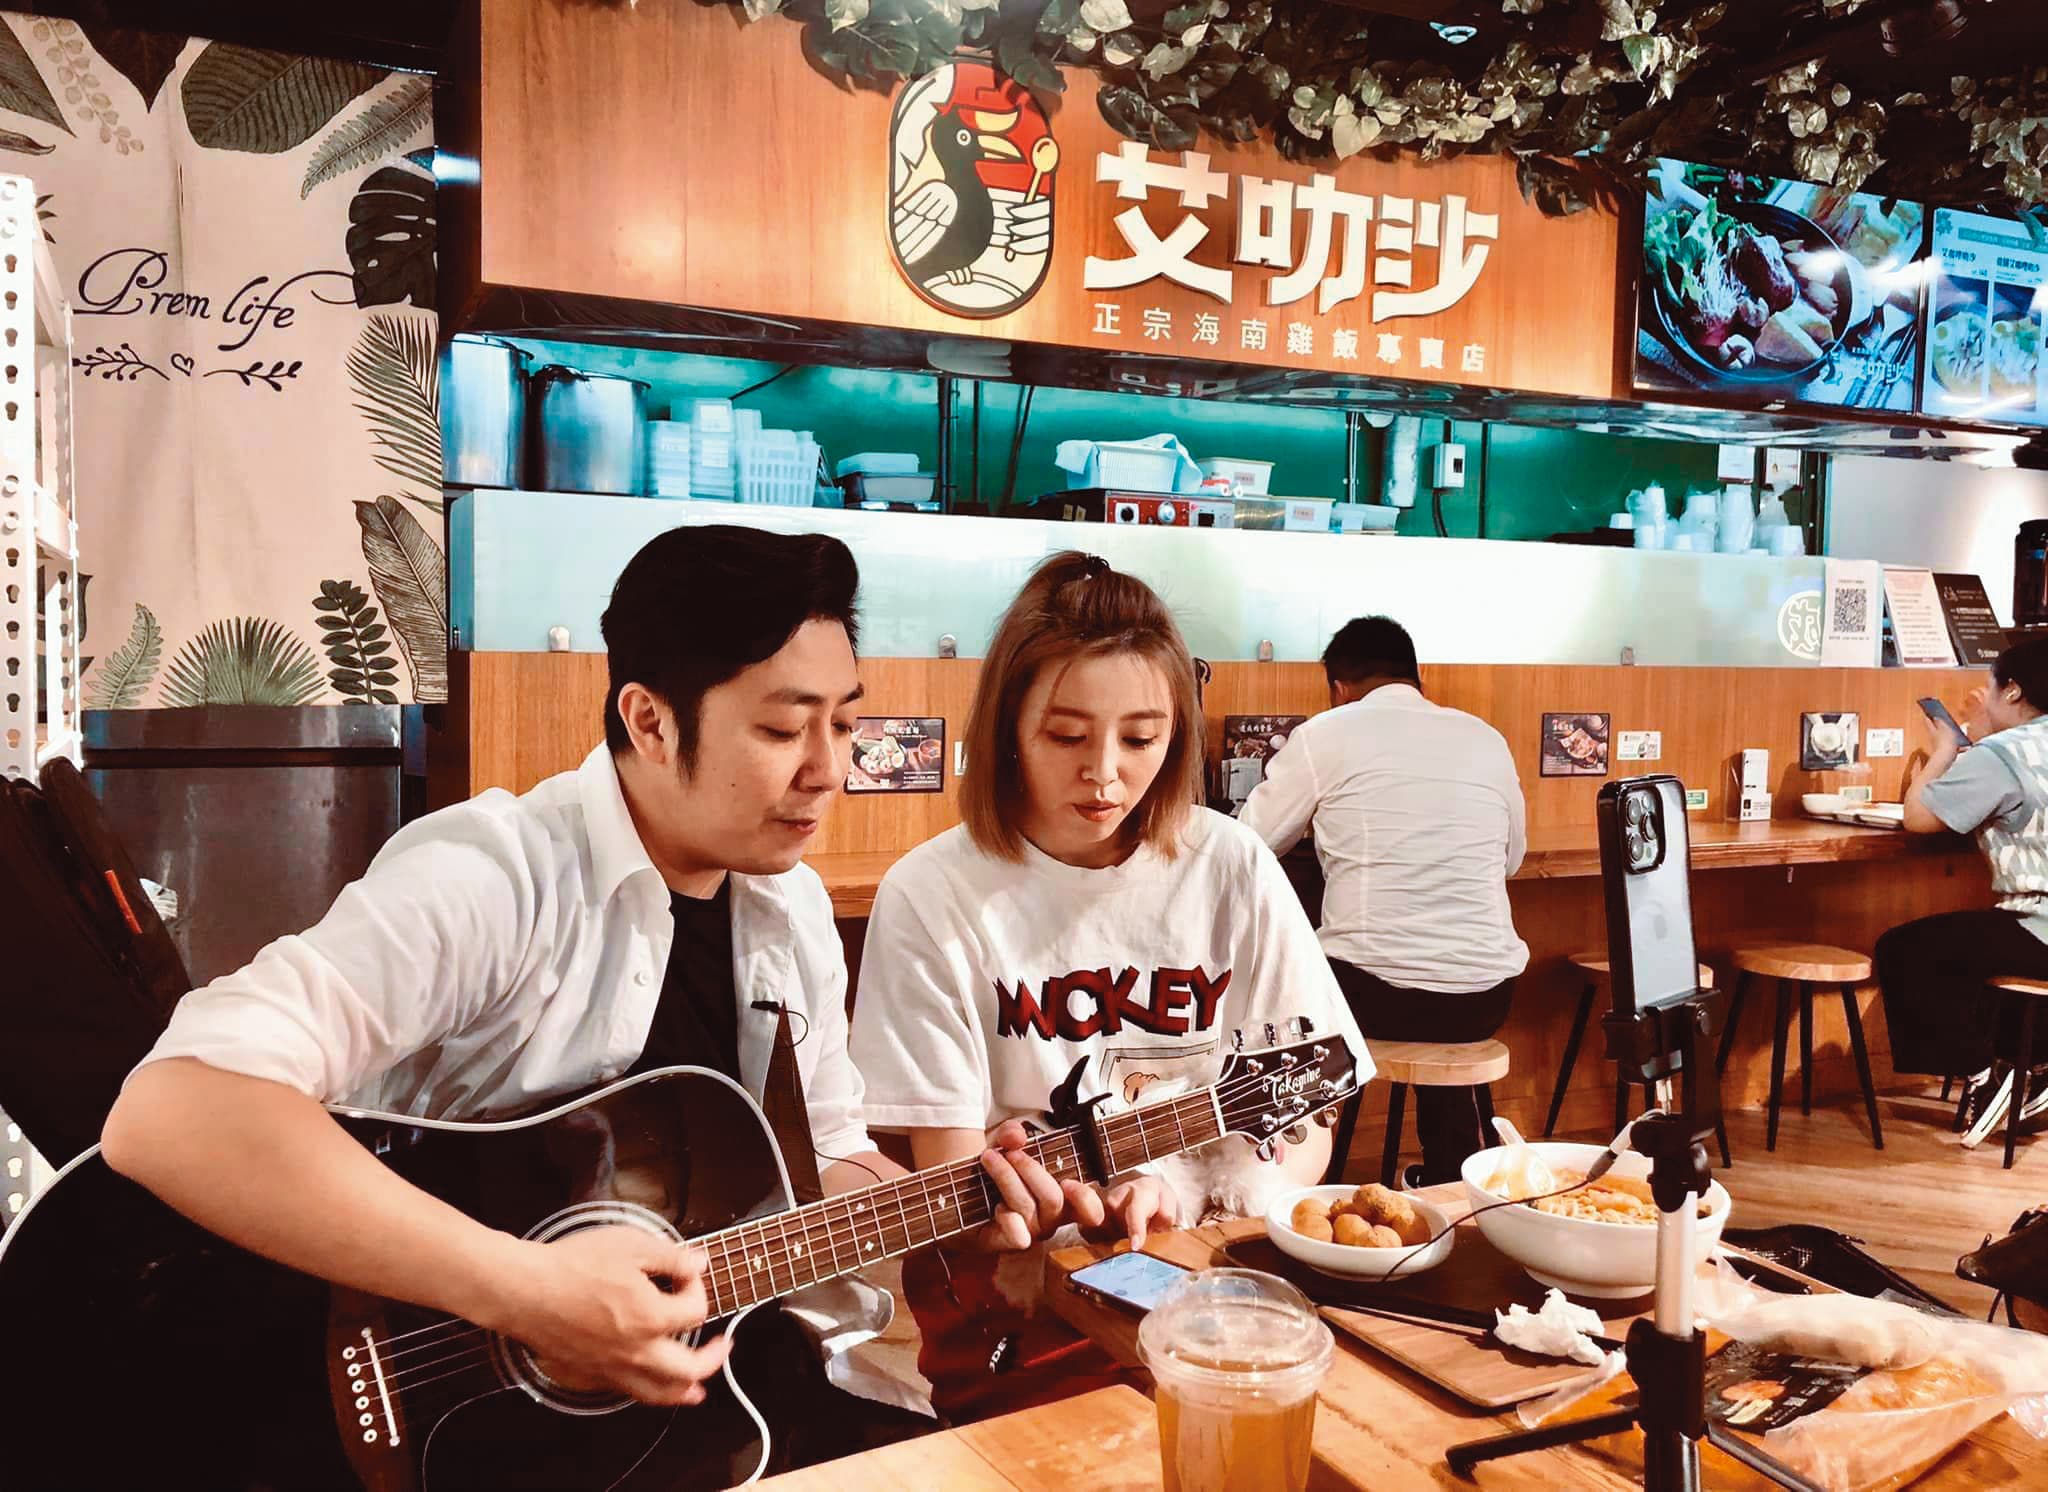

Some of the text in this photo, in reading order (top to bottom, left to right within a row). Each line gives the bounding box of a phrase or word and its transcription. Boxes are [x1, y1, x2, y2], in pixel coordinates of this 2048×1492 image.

[73, 248, 355, 352] Prem life
[1084, 141, 1499, 324] 艾叻沙
